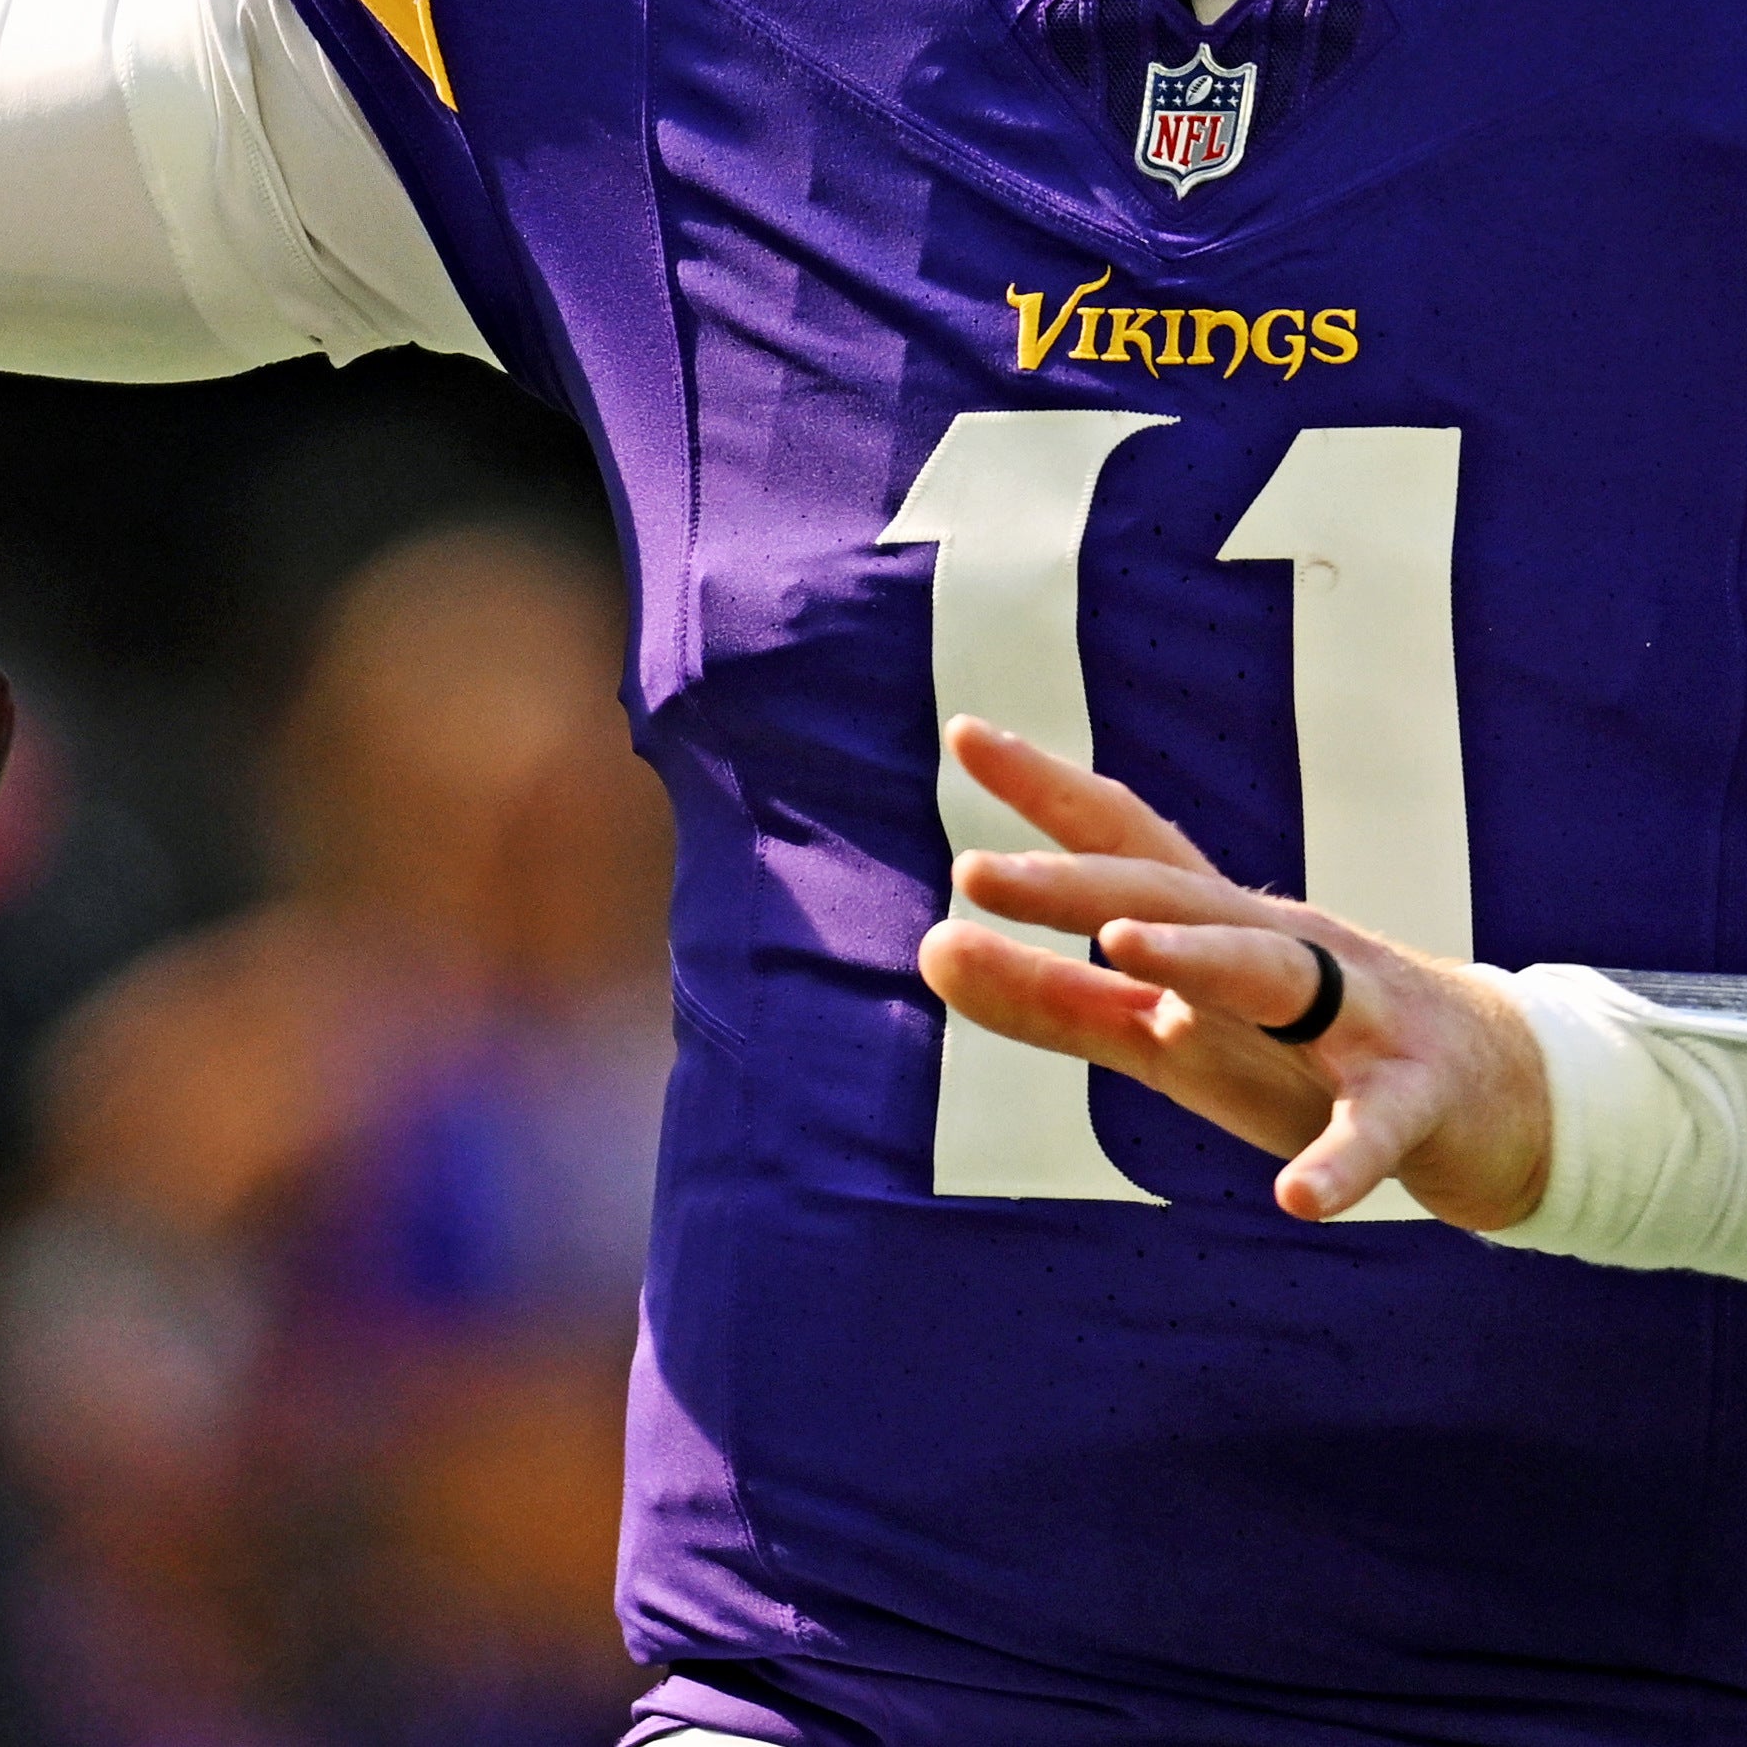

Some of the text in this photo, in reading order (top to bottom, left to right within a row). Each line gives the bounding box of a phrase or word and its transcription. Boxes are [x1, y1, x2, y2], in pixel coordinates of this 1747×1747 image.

[1151, 114, 1227, 168] NFL
[1005, 264, 1360, 382] VIKINGS
[874, 409, 1474, 1222] 11
